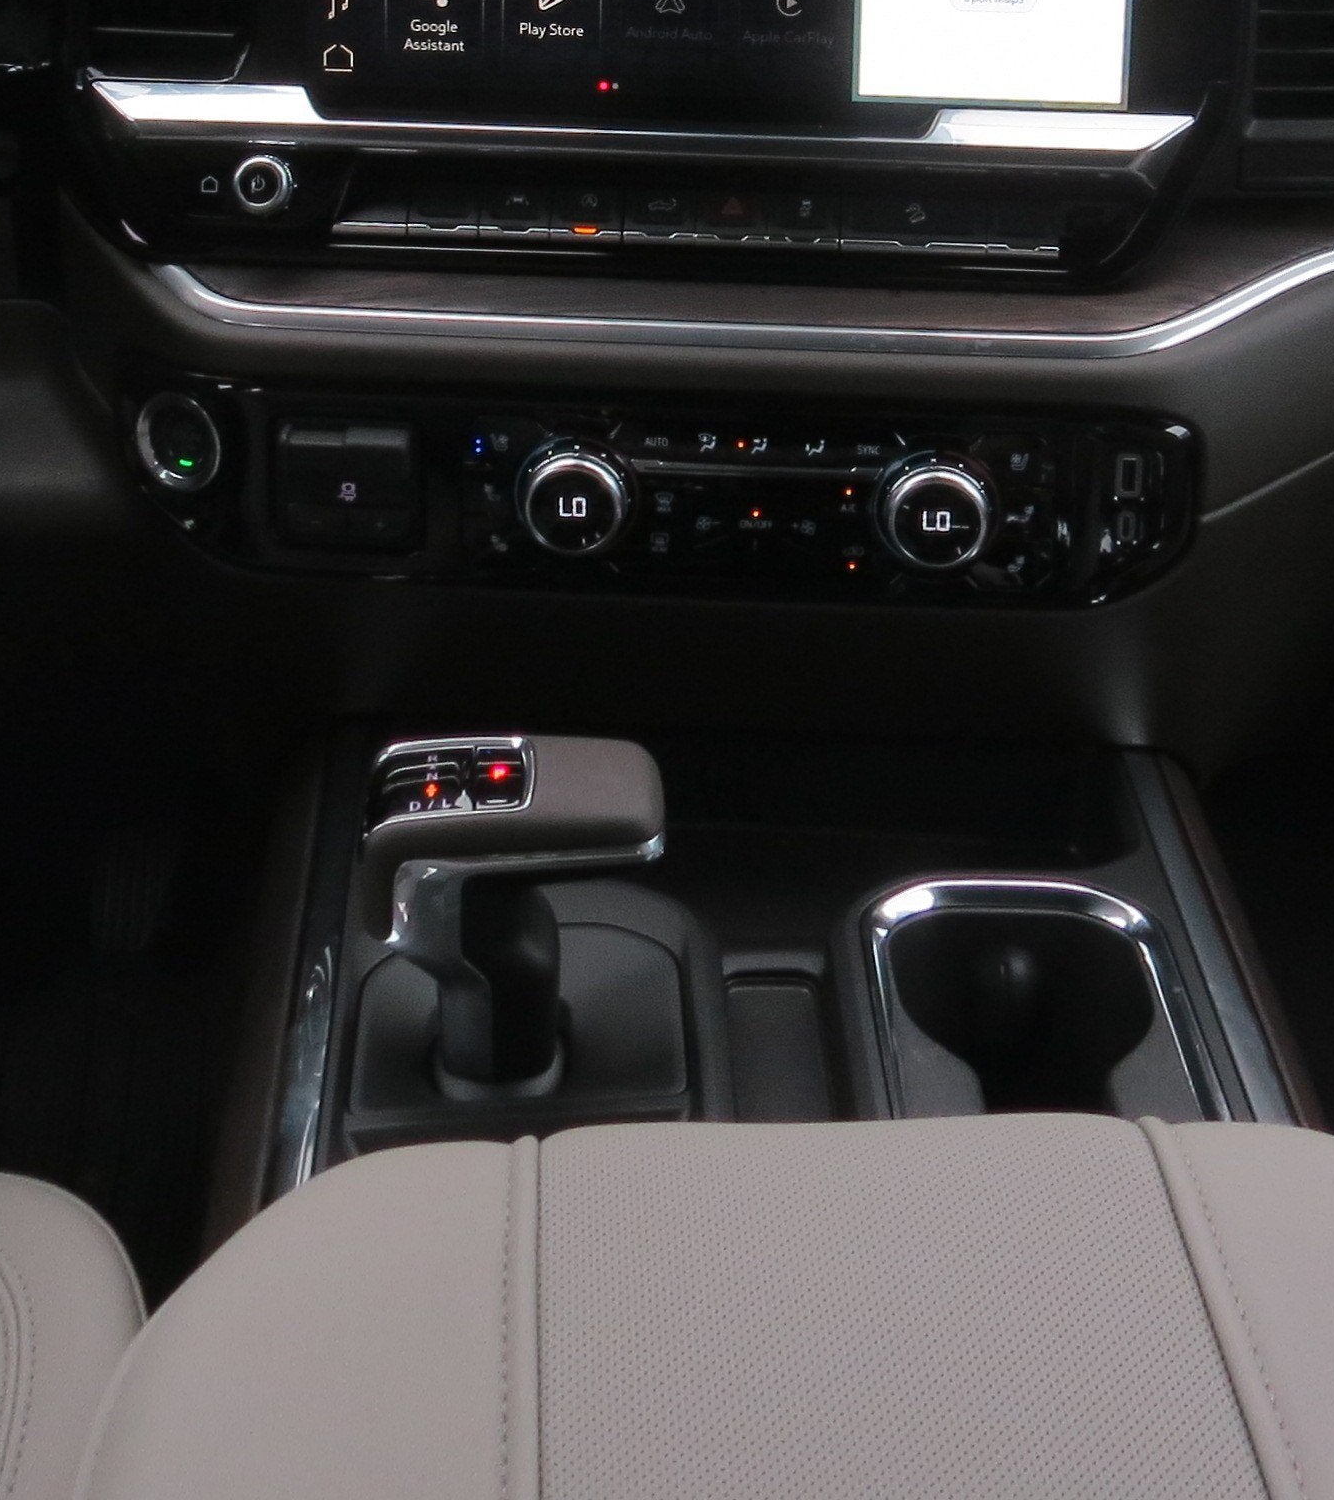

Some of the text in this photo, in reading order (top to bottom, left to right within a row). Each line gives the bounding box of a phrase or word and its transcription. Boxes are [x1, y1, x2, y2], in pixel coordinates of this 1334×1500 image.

[410, 19, 458, 35] Google
[519, 23, 584, 39] Play Store
[403, 38, 465, 52] Assistant
[644, 437, 669, 448] AUTO
[857, 445, 881, 455] SYNC
[559, 496, 587, 517] LO
[922, 510, 951, 532] LO
